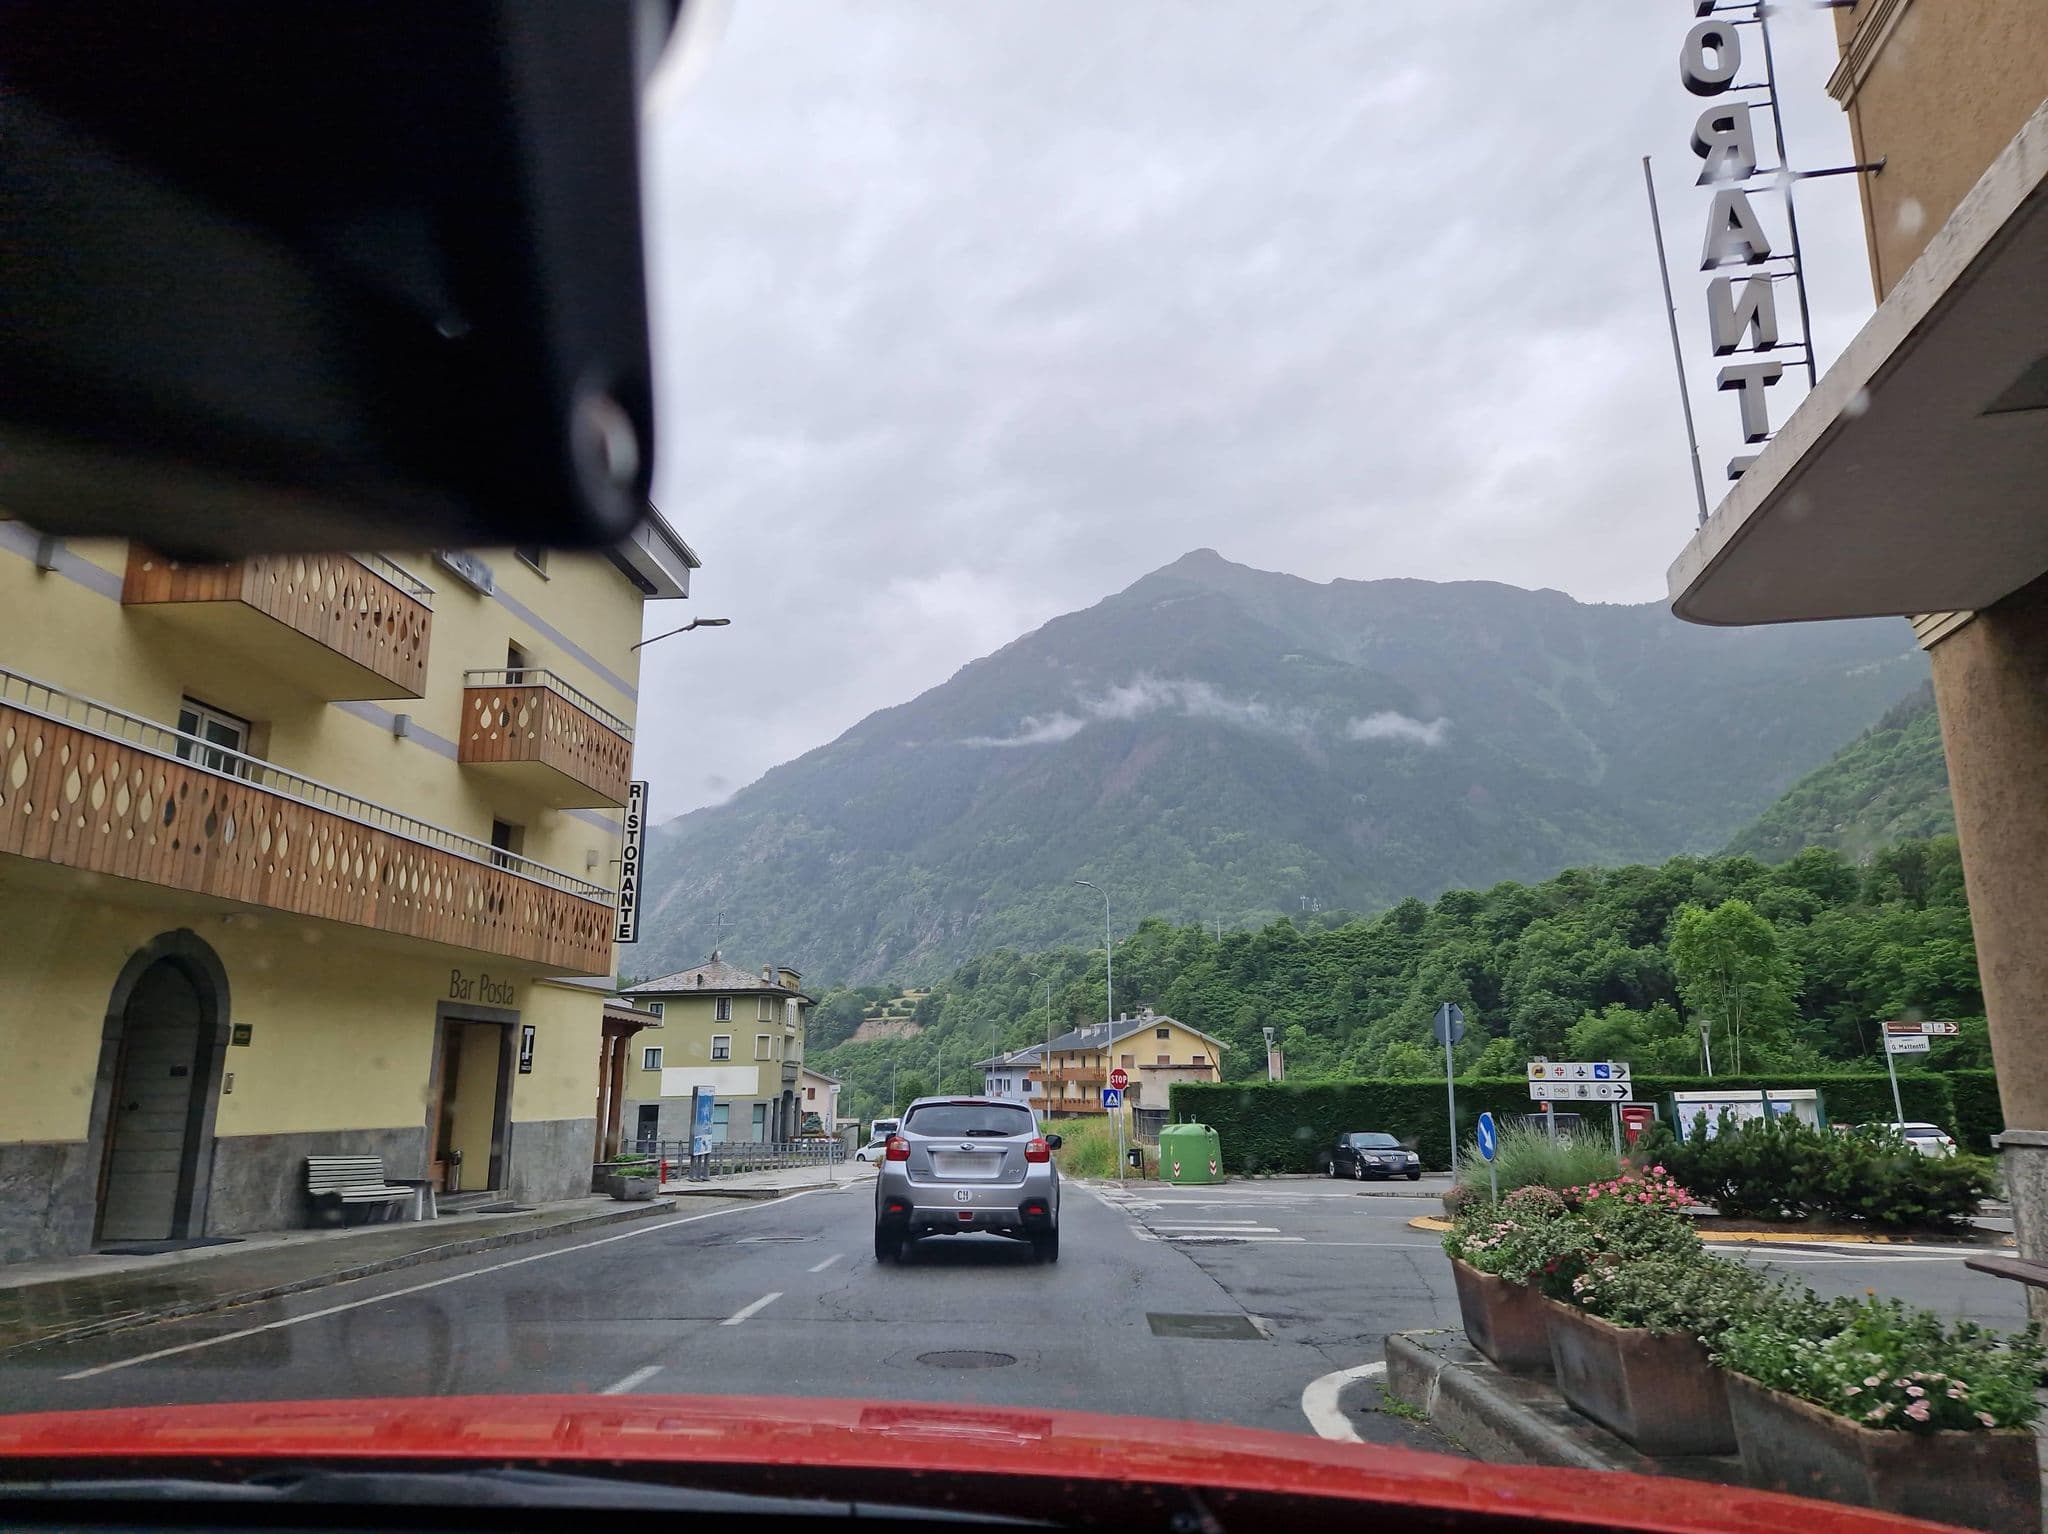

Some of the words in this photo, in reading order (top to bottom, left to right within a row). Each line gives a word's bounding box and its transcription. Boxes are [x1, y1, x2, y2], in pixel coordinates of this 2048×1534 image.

[618, 784, 642, 939] RISTORANTE
[449, 969, 475, 1000] Bar
[479, 974, 514, 1005] Posta
[1110, 1074, 1127, 1085] STOP
[957, 1190, 969, 1201] CH
